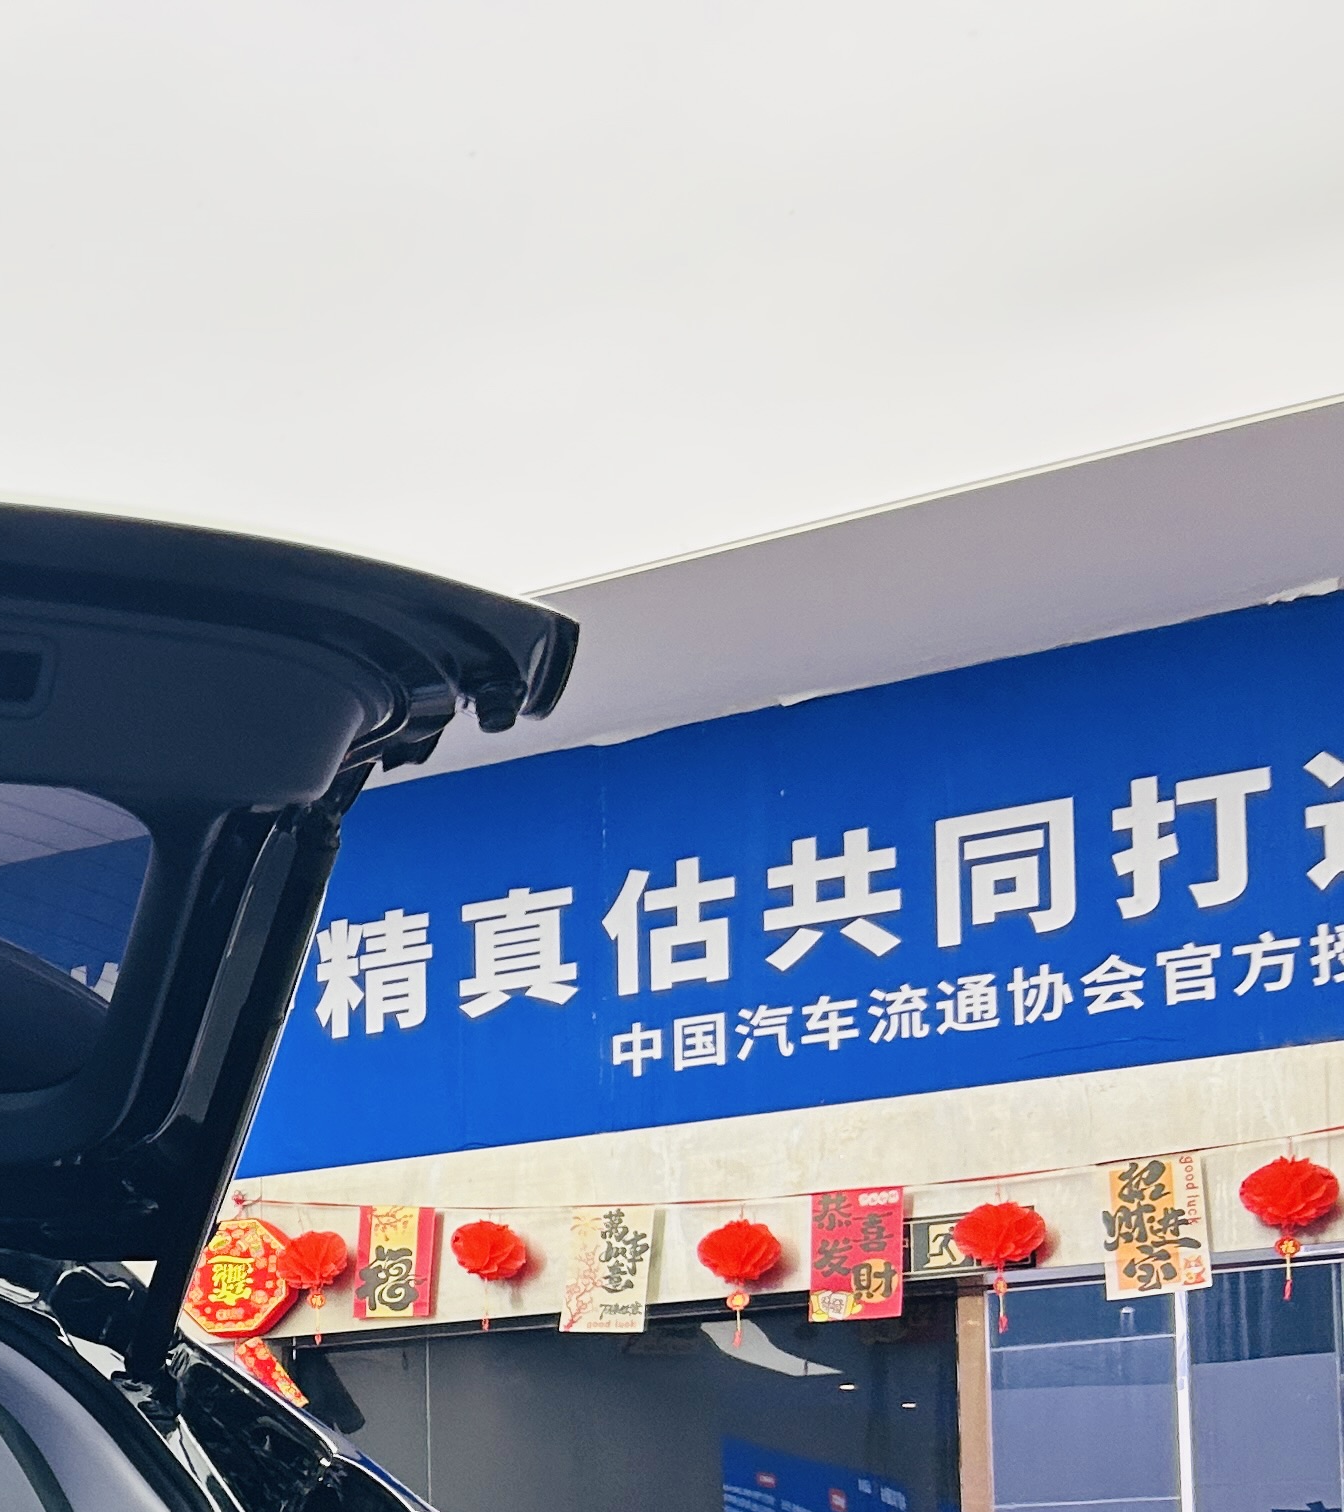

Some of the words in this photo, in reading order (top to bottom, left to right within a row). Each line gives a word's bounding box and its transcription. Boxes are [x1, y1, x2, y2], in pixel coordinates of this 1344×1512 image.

[315, 752, 1344, 1040] 精真估共同打
[1179, 1156, 1198, 1190] good
